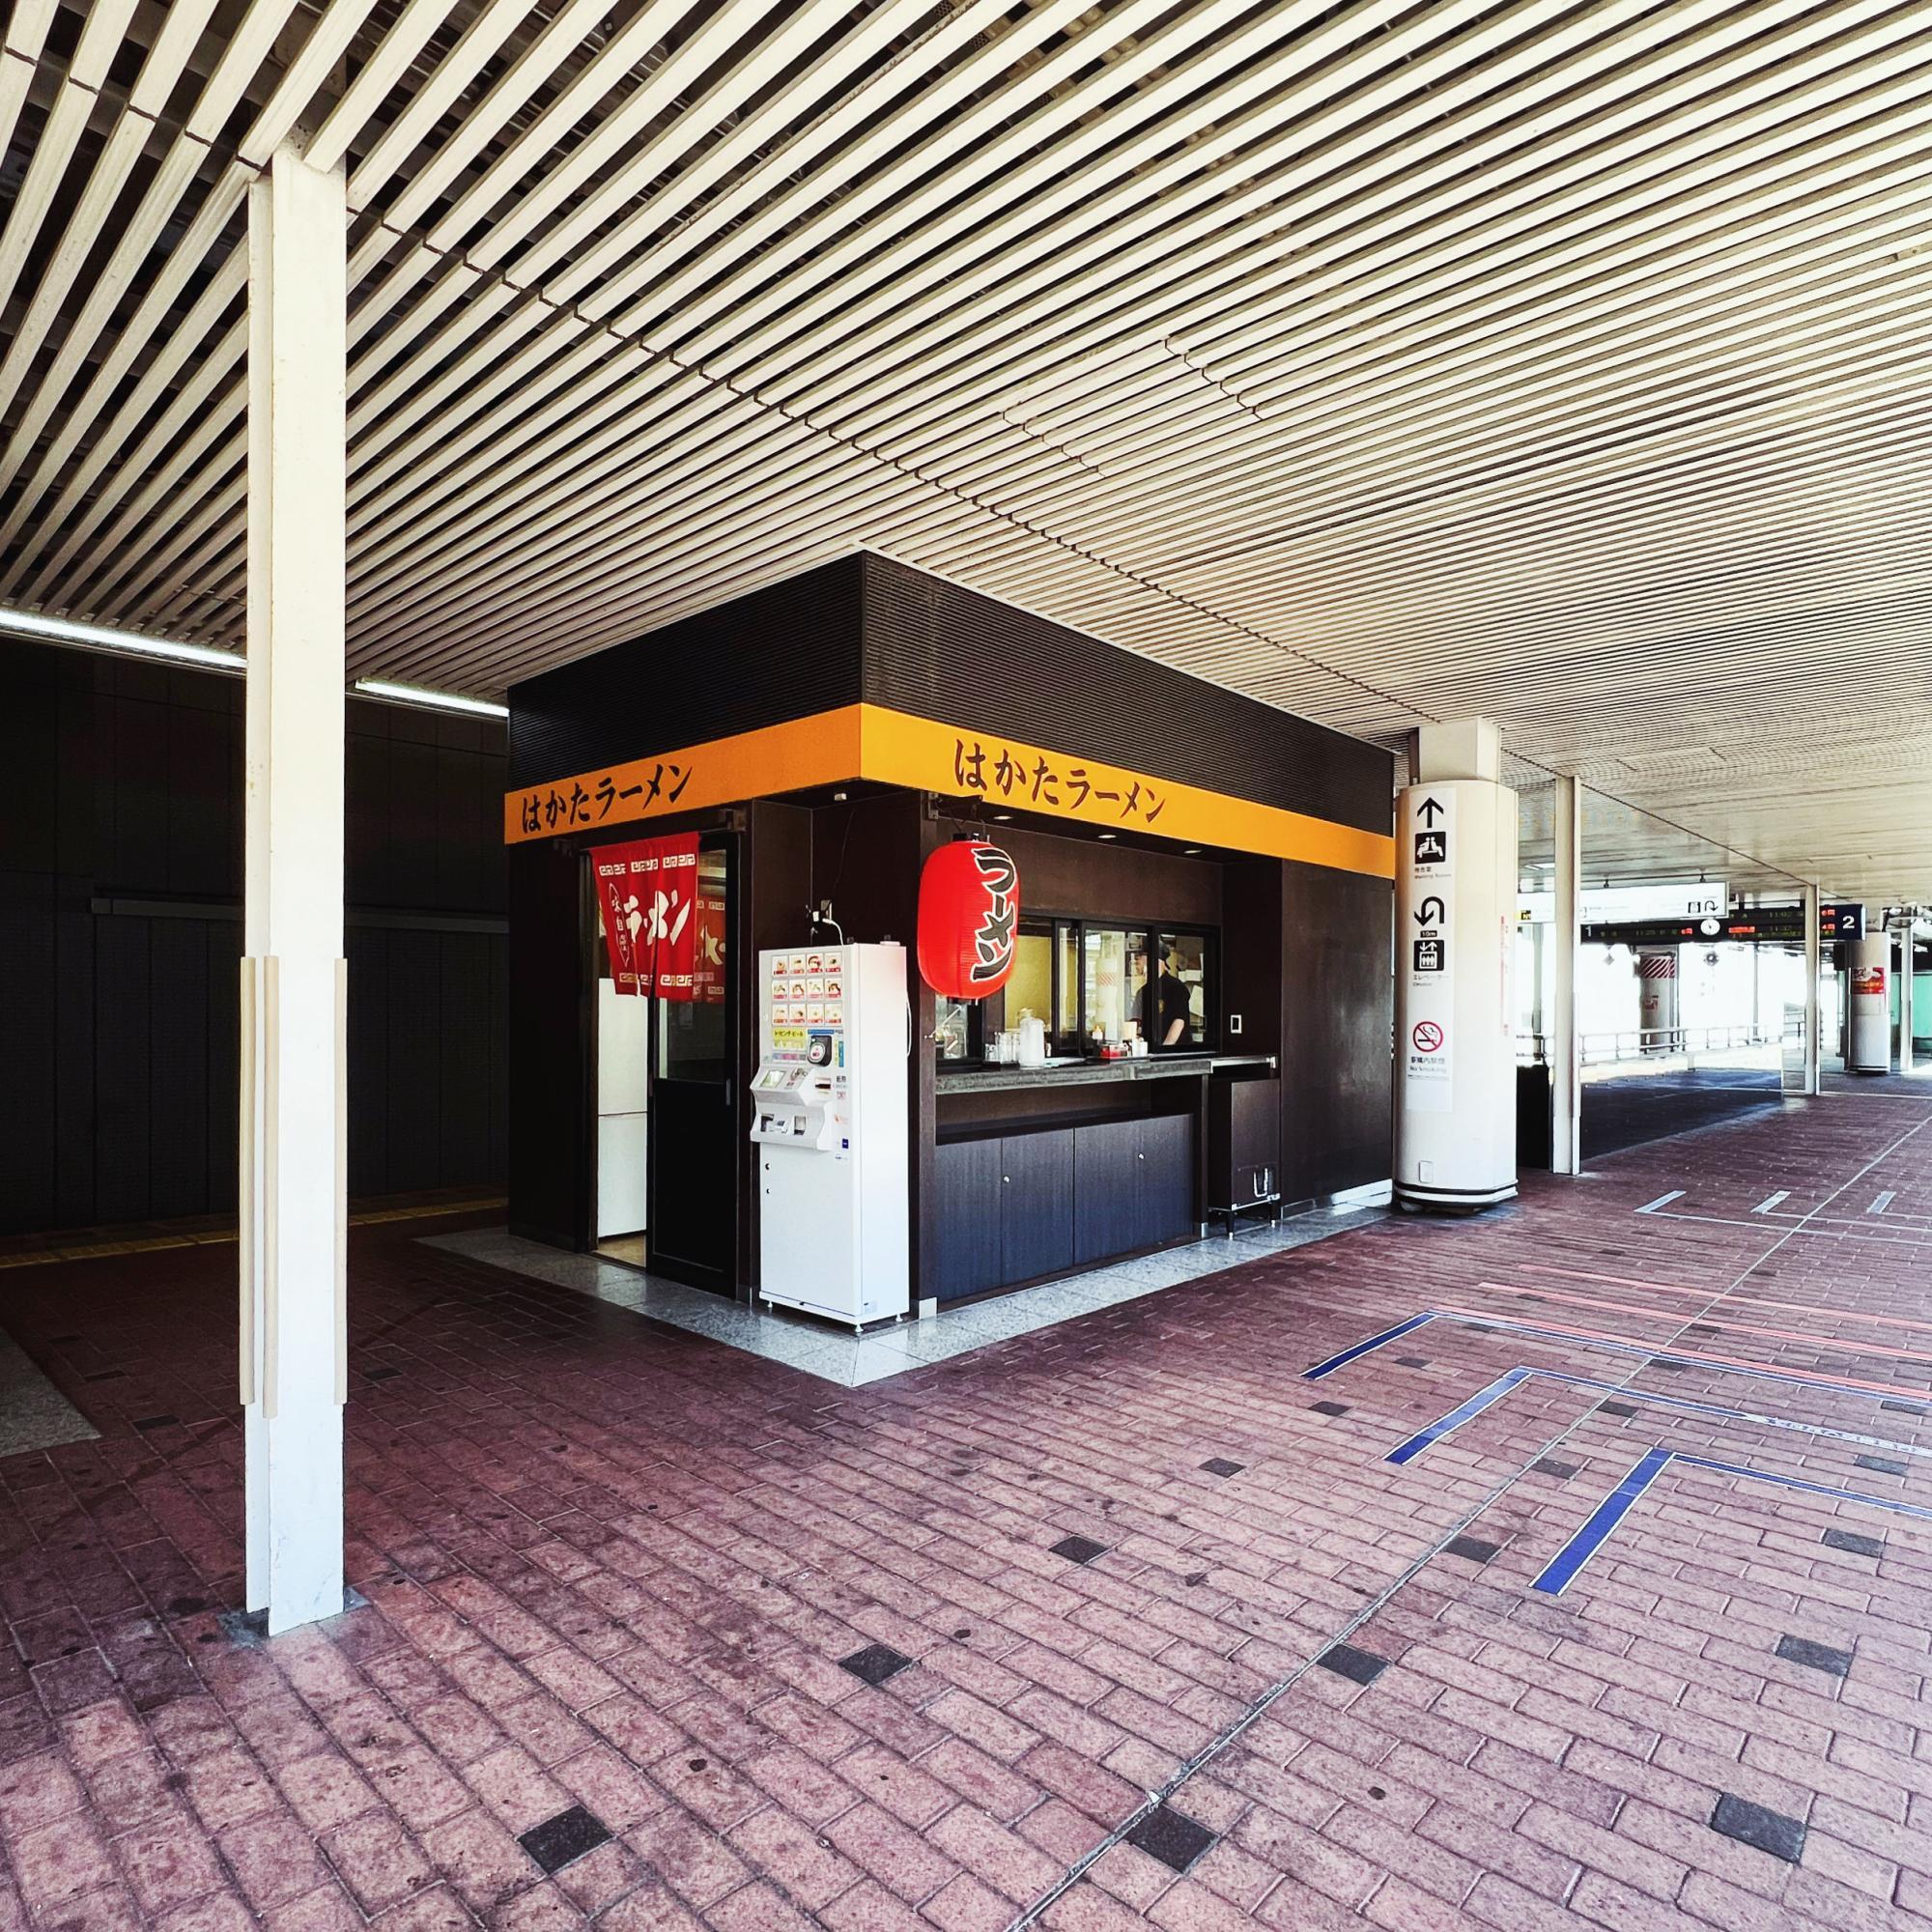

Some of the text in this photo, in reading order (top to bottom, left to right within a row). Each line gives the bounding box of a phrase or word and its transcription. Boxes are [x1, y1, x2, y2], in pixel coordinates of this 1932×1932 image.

[523, 763, 693, 834] はかたラーメン
[955, 738, 1165, 823] はかたラーメン
[970, 847, 1015, 982] ラーメン
[1585, 925, 1592, 937] 1
[1842, 915, 1856, 929] 2
